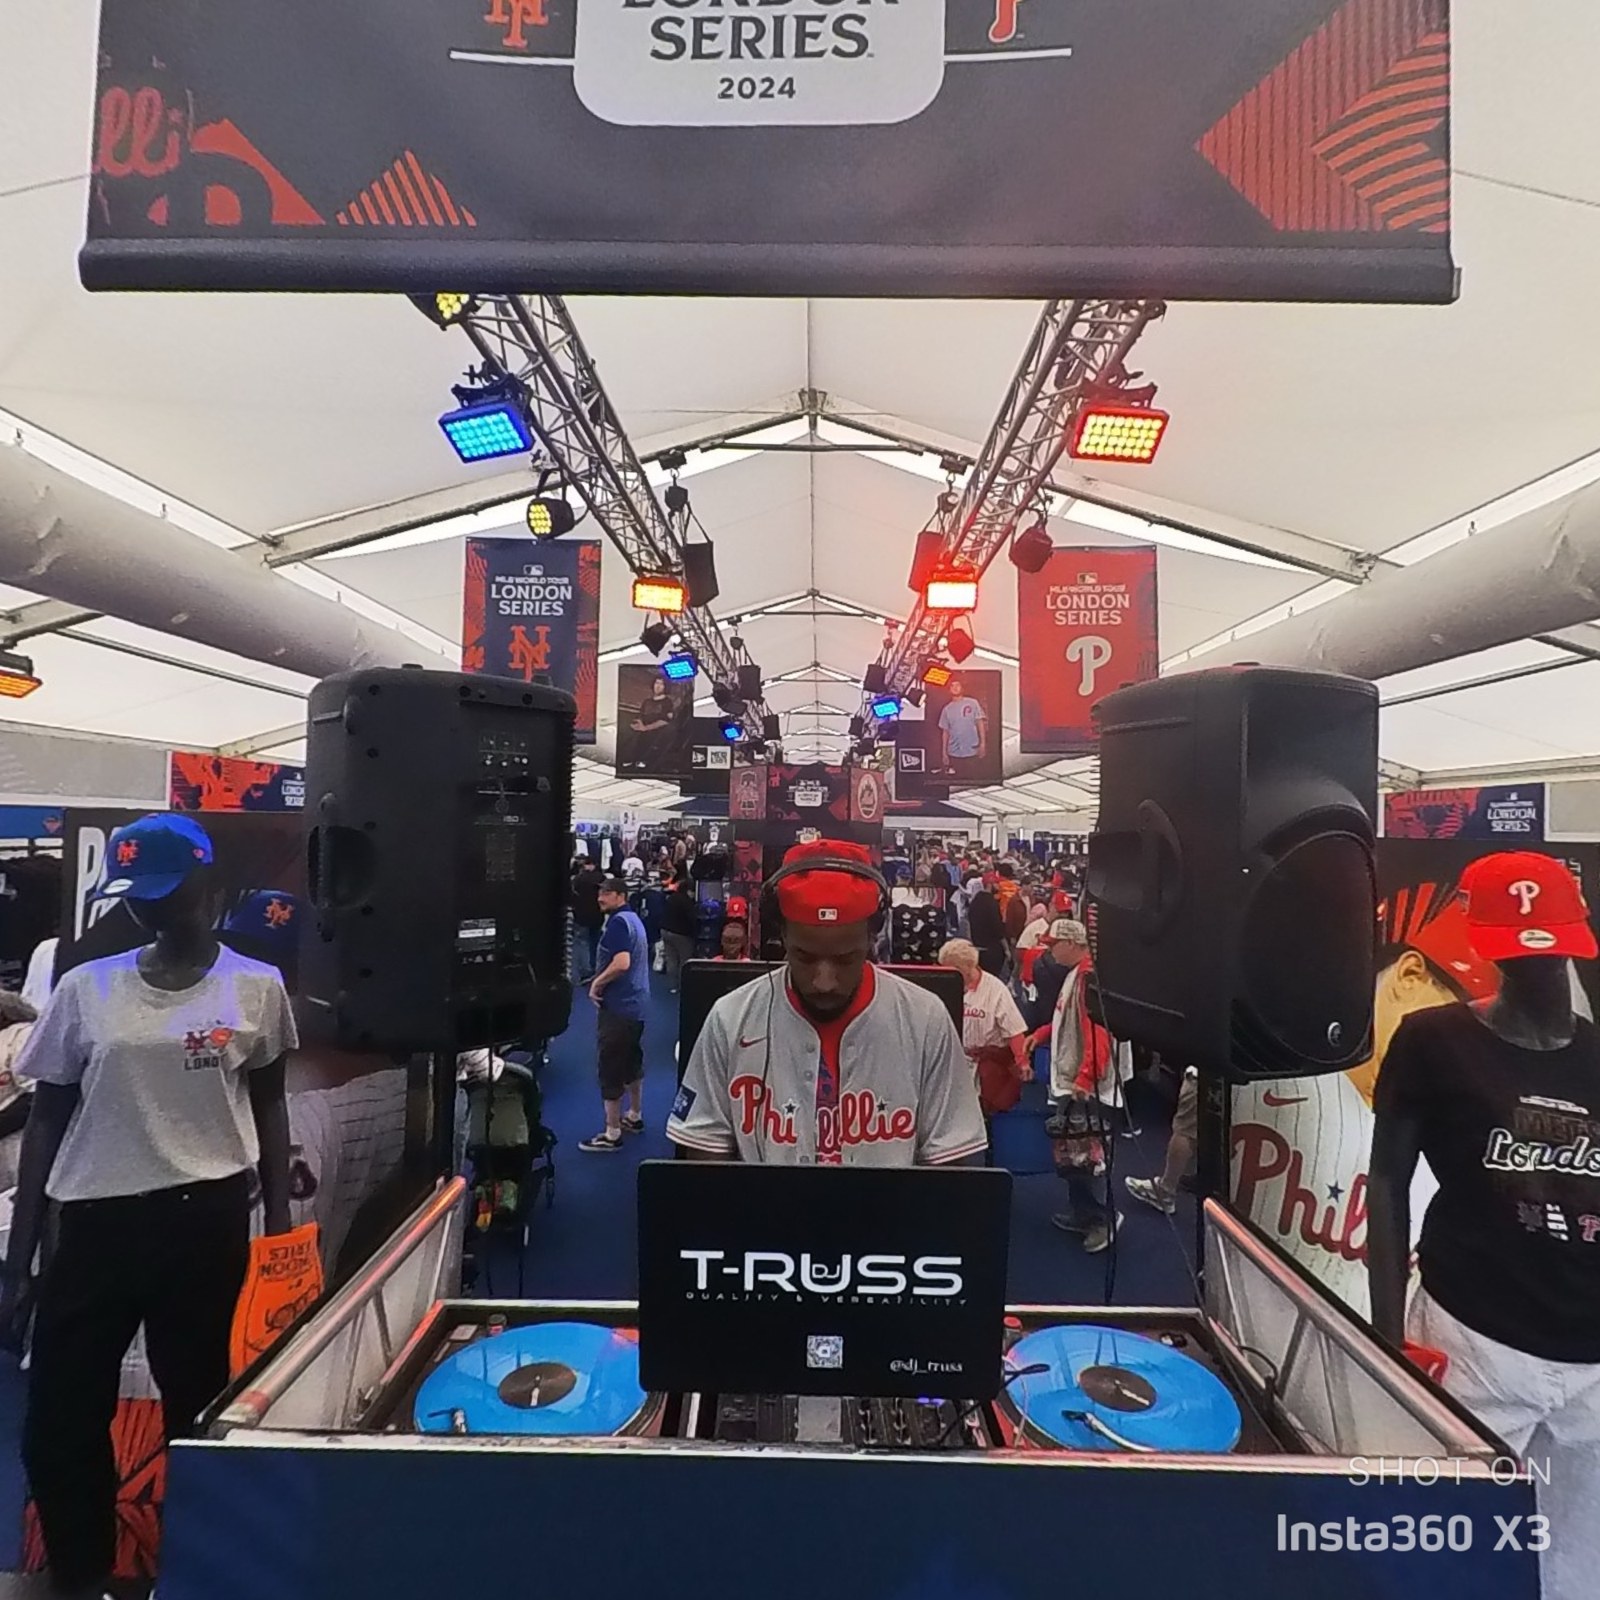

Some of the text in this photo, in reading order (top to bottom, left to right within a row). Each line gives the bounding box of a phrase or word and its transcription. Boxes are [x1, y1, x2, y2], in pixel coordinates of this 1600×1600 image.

[649, 13, 870, 61] SERIES
[717, 76, 796, 100] 2024
[490, 583, 573, 600] LONDON
[498, 600, 564, 617] SERIES
[1045, 593, 1131, 610] LONDON
[1054, 609, 1123, 626] SERIES
[1065, 635, 1113, 697] P
[1486, 807, 1537, 821] LONDON
[1490, 819, 1531, 833] SERIES
[1507, 880, 1541, 915] P
[680, 1250, 963, 1296] T-RUSS
[685, 1291, 778, 1302] QUALITY
